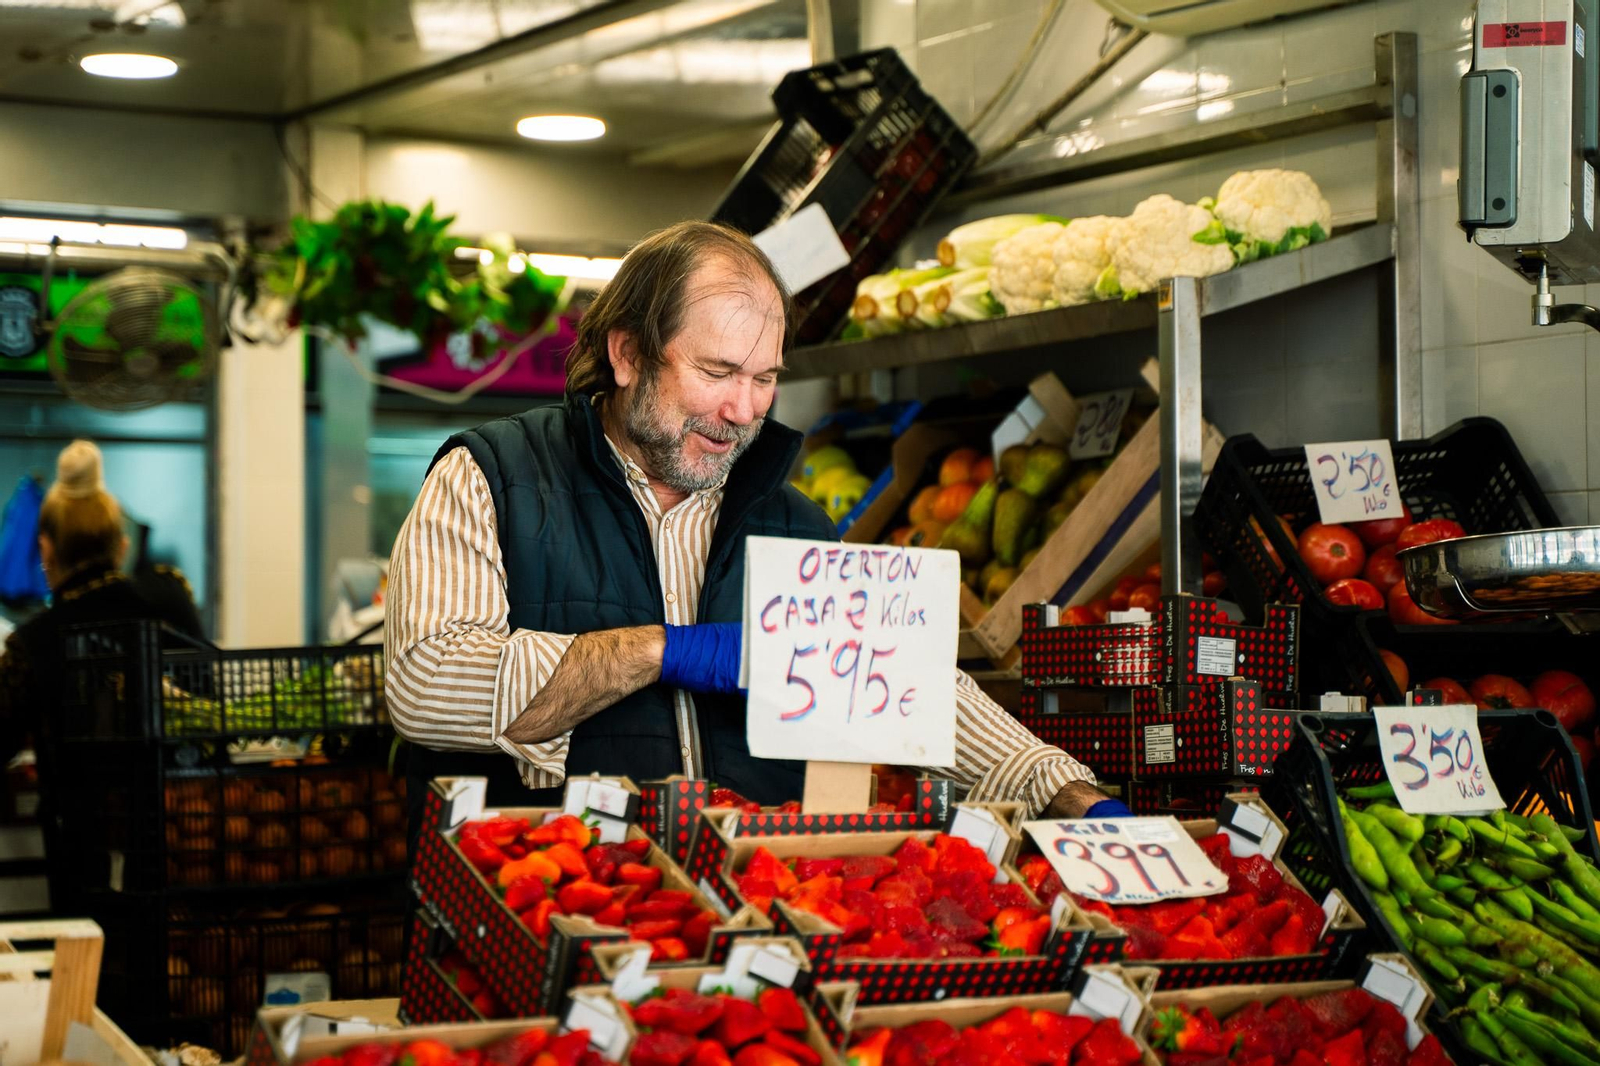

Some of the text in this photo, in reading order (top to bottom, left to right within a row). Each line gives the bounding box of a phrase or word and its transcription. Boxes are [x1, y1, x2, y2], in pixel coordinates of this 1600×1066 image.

[1317, 446, 1385, 499] 2'50
[845, 590, 868, 631] 2
[881, 592, 926, 627] Kilos
[777, 638, 917, 723] 5'95 €
[1390, 723, 1473, 790] 3'50
[1053, 837, 1192, 895] 3'99
